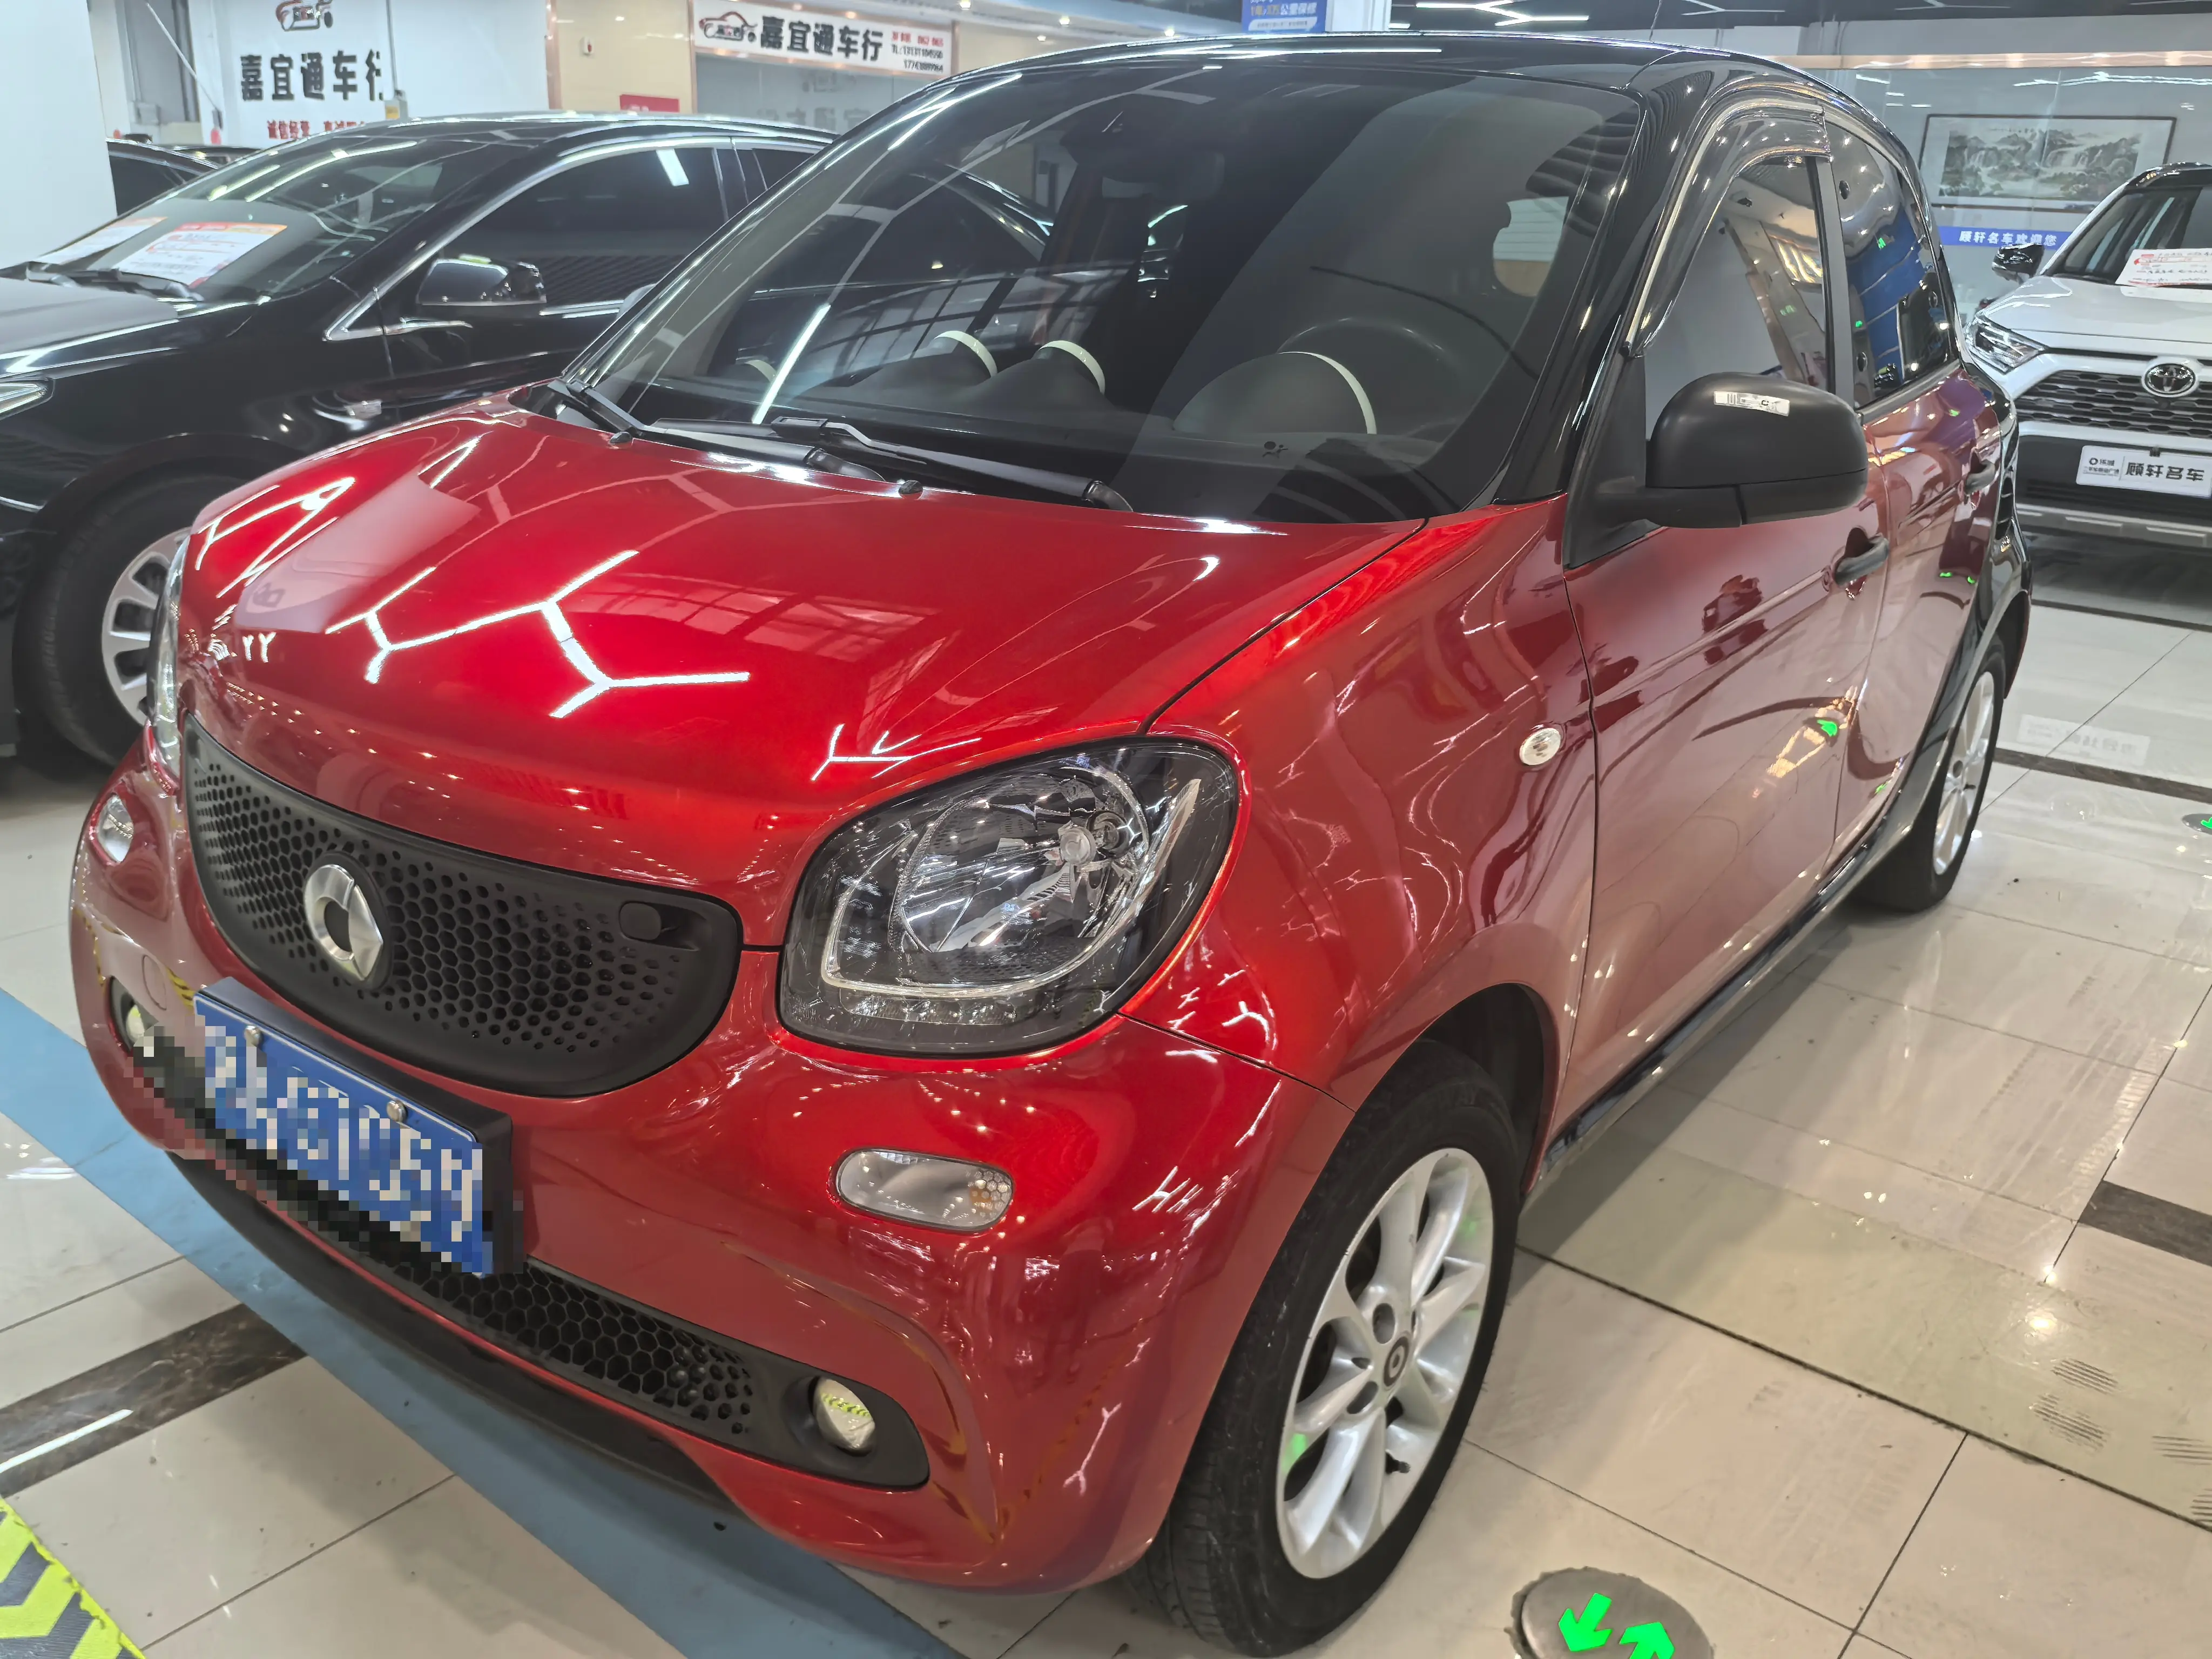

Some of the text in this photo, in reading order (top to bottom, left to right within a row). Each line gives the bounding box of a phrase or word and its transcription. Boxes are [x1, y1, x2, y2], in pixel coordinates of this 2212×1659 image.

[760, 16, 883, 62] 嘉宜通车行
[1959, 231, 2057, 247] 顾轩名车欢迎您
[2126, 462, 2205, 481] 顾轩名车
